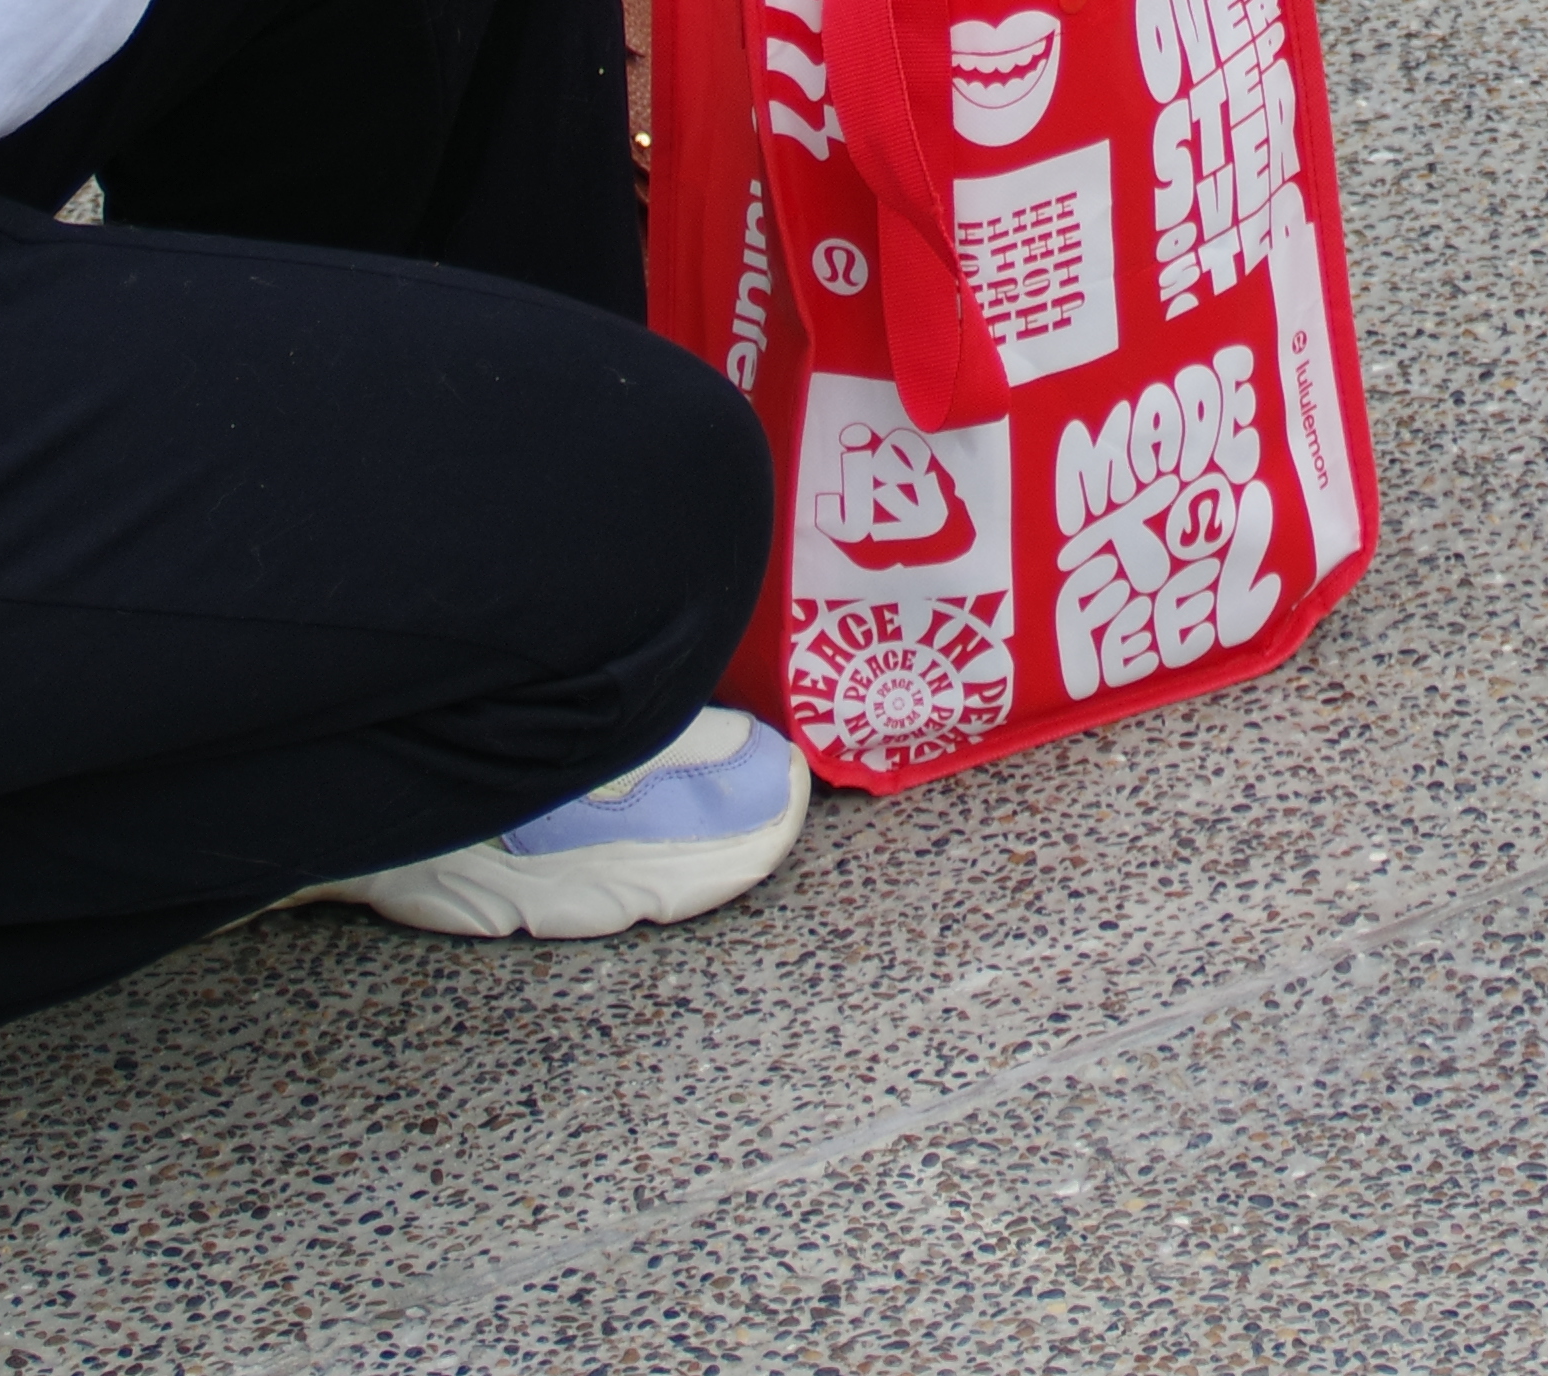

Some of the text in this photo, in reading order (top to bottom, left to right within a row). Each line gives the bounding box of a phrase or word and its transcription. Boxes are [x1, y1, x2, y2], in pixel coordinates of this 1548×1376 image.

[1153, 21, 1286, 231] STEP
[1156, 59, 1301, 264] OVER
[957, 190, 1078, 246] ELIEF
[990, 222, 1083, 274] THE
[970, 254, 1083, 313] RST
[985, 290, 1086, 347] TEP
[1056, 344, 1261, 537] MADE
[1295, 359, 1330, 491] lululemon
[1056, 479, 1282, 702] FEEL
[791, 602, 904, 726] PEACE
[915, 608, 994, 675] IN
[842, 648, 917, 704] PEACE
[876, 677, 915, 698] PEACE
[918, 658, 955, 698] IN
[843, 710, 879, 746] IN
[882, 706, 922, 729] PEACE
